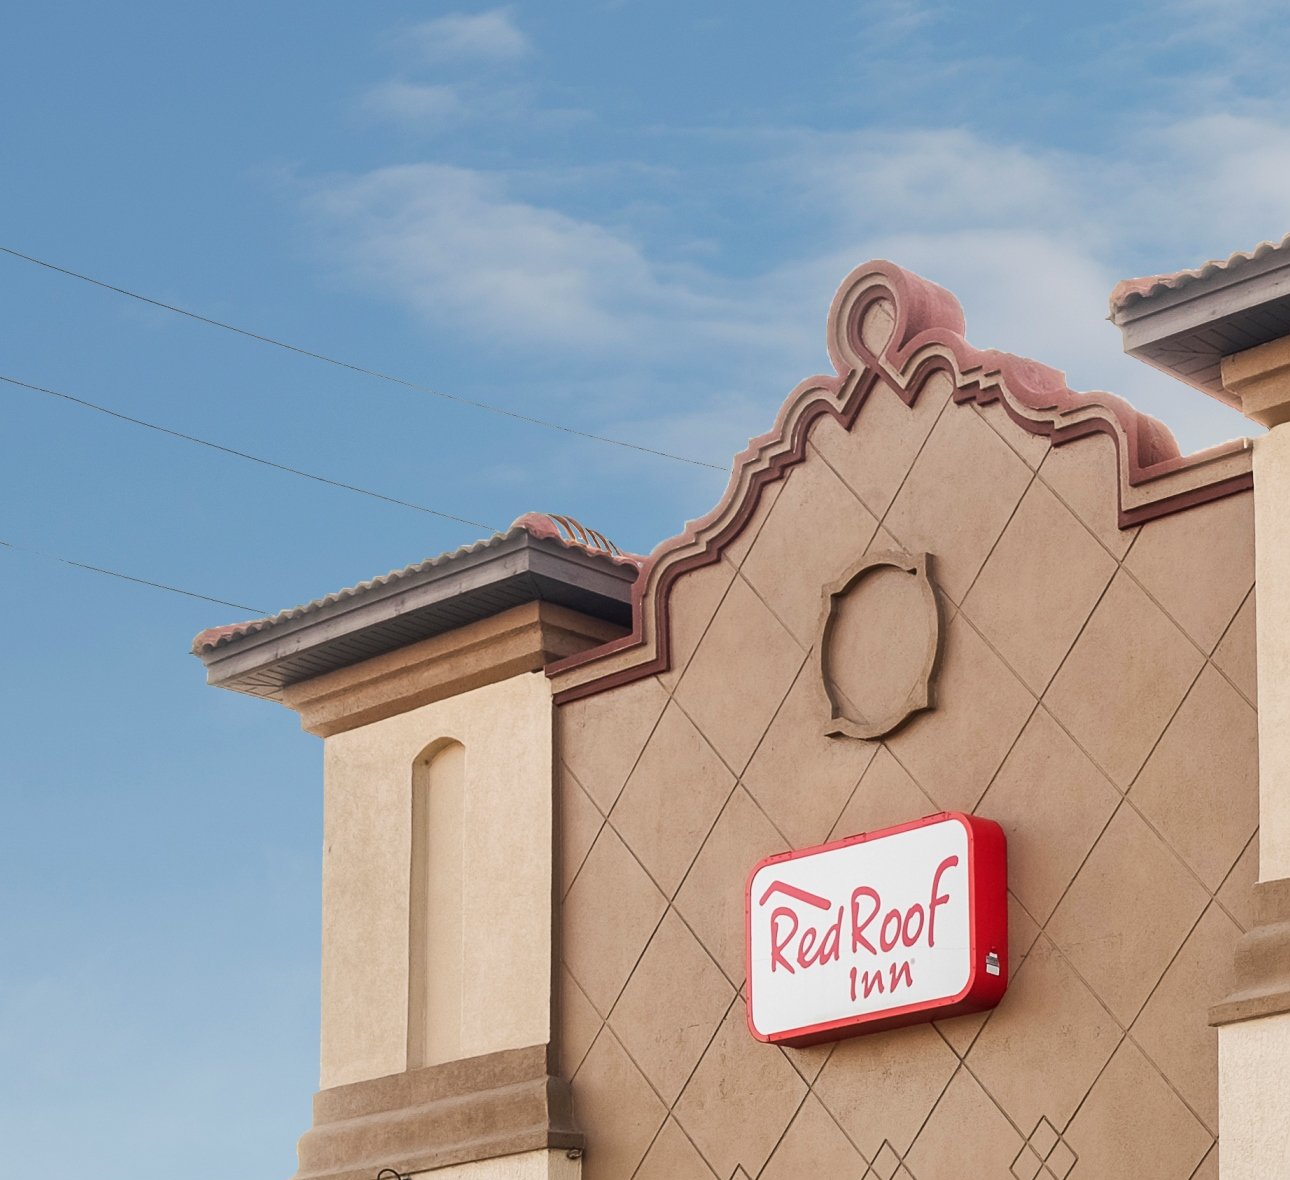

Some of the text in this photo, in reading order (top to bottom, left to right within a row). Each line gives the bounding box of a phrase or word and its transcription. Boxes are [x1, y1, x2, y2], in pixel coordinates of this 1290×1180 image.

[770, 854, 960, 975] Red Roof
[849, 960, 914, 1002] Inn
